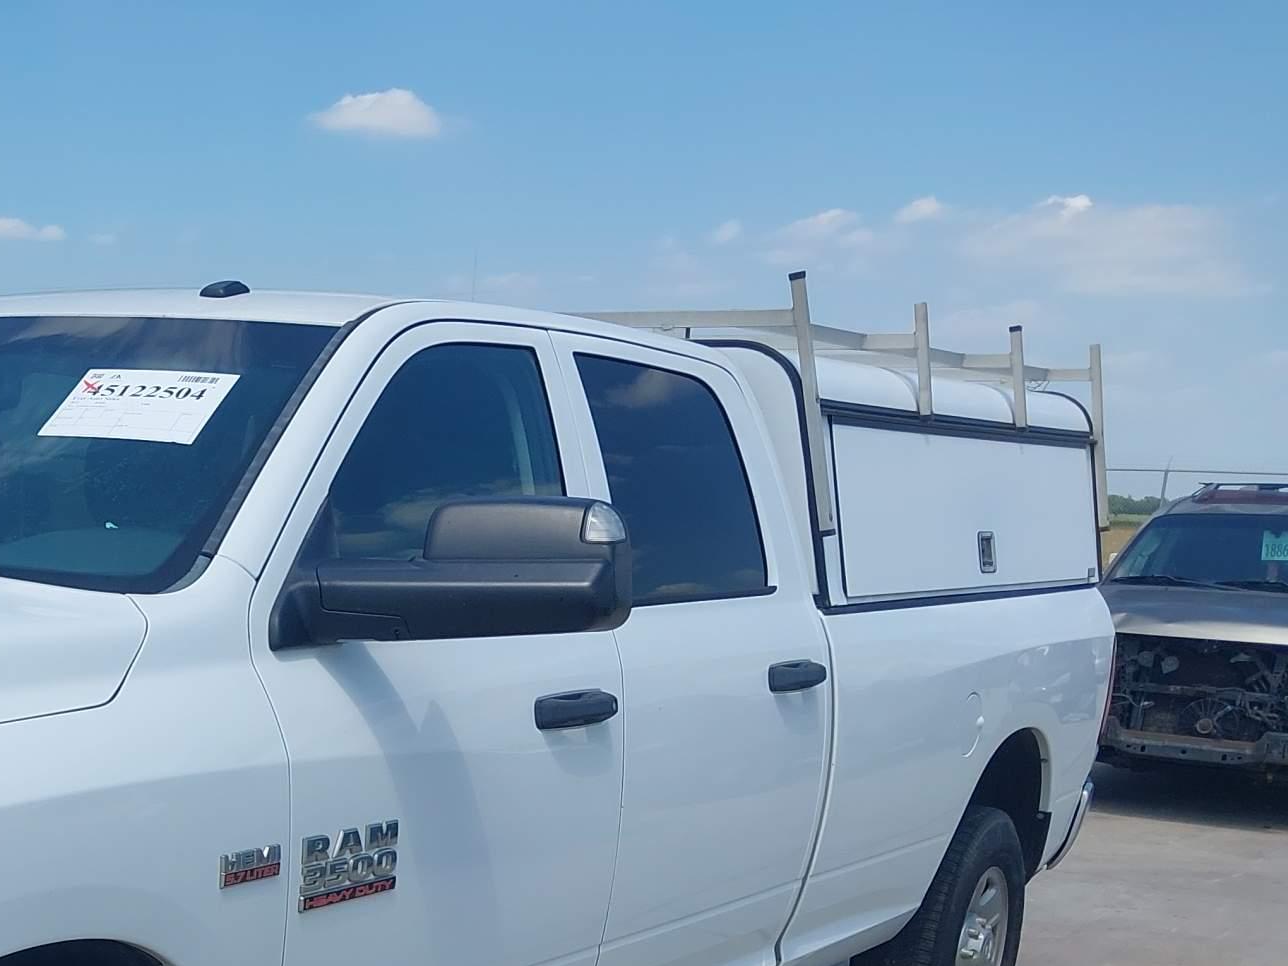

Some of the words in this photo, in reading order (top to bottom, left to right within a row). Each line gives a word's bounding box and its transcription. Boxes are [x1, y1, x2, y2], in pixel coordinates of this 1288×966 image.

[86, 383, 207, 400] 45122504
[301, 819, 399, 863] RAM
[219, 843, 281, 873] HEMI
[225, 871, 246, 886] 5.7
[246, 863, 280, 880] LITER
[305, 887, 355, 909] HEAVY
[355, 879, 394, 897] DUTY
